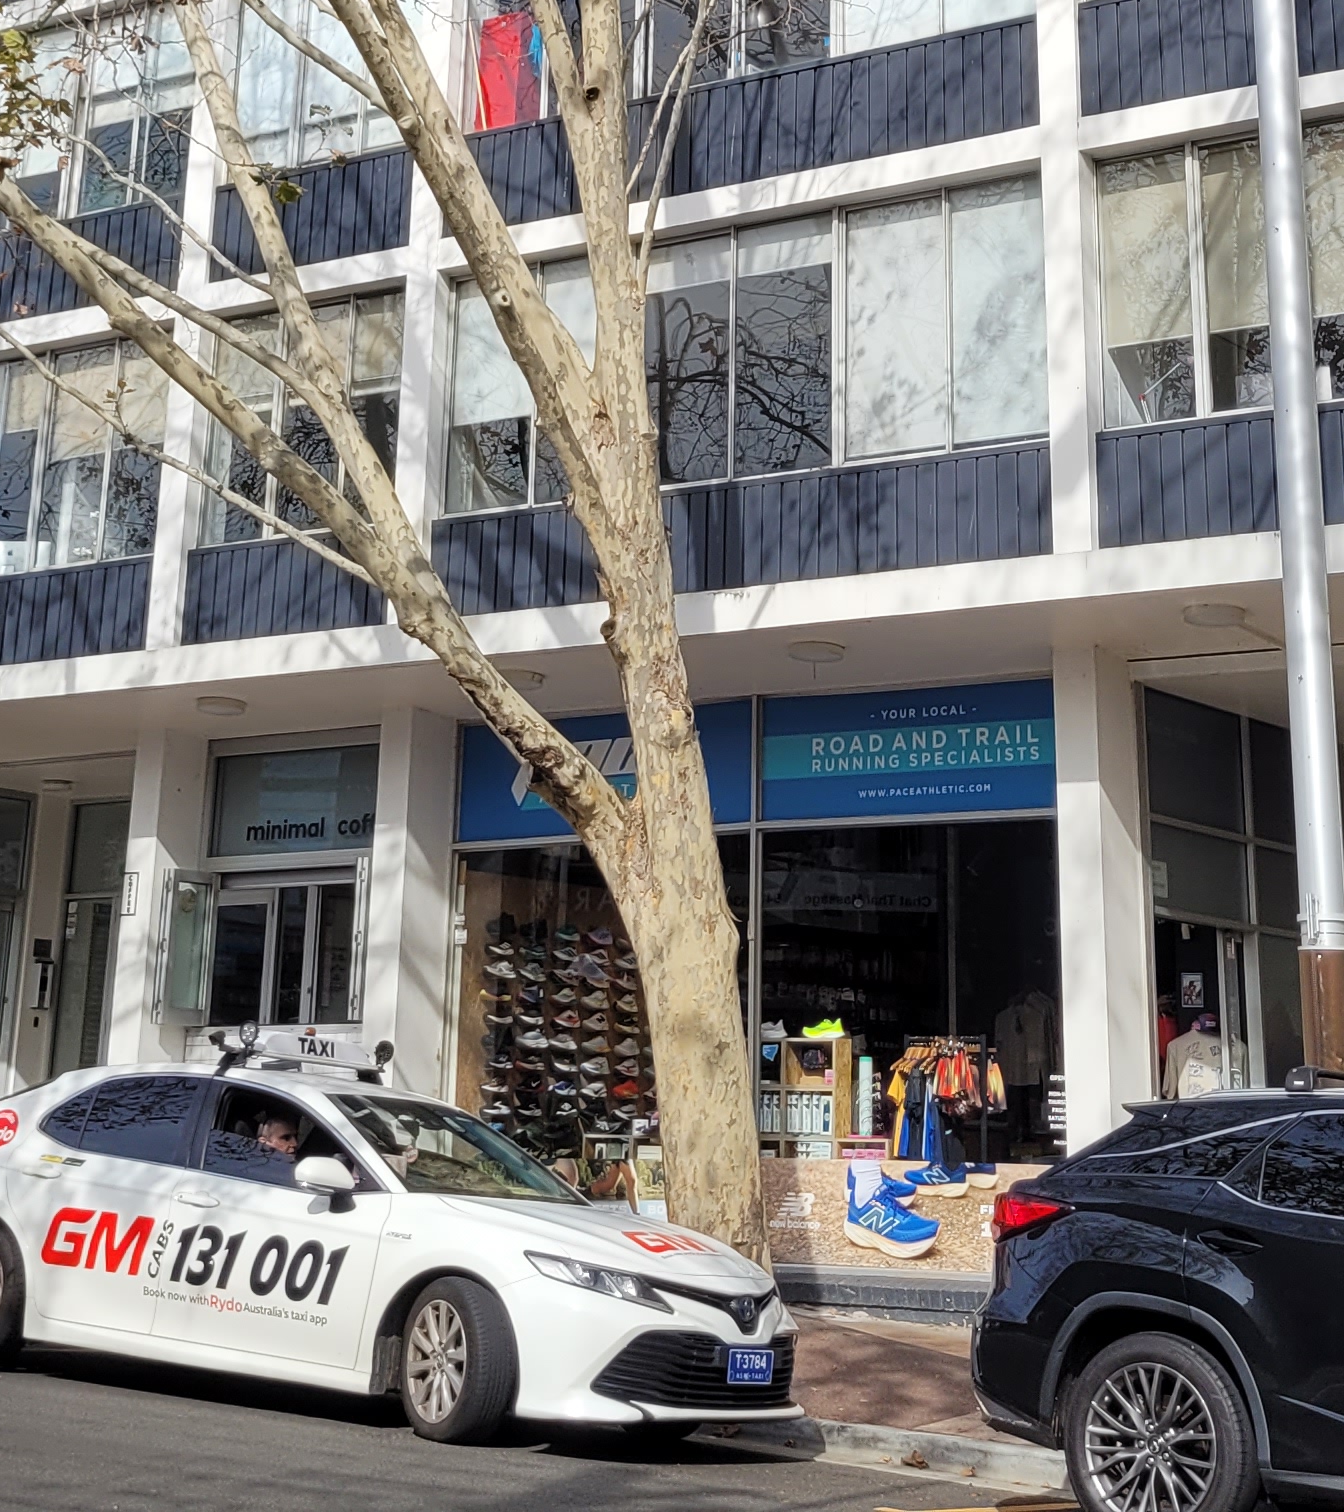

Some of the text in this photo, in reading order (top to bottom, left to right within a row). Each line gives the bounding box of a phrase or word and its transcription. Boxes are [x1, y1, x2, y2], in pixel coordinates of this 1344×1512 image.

[881, 704, 967, 720] YOUR LOCAL
[811, 724, 1039, 757] ROAD AND TRAIL
[811, 746, 1040, 773] RUNNING SPECIALISTS
[858, 783, 992, 799] WWW.PACEATHLETIC.COM
[246, 817, 325, 841] minimal
[298, 1037, 335, 1058] TAXI
[41, 1207, 155, 1276] GM
[147, 1219, 175, 1279] CABS
[621, 1231, 718, 1253] GM
[169, 1224, 351, 1305] 131 001
[143, 1286, 328, 1327] Book now with Rydo Australia's taxi app
